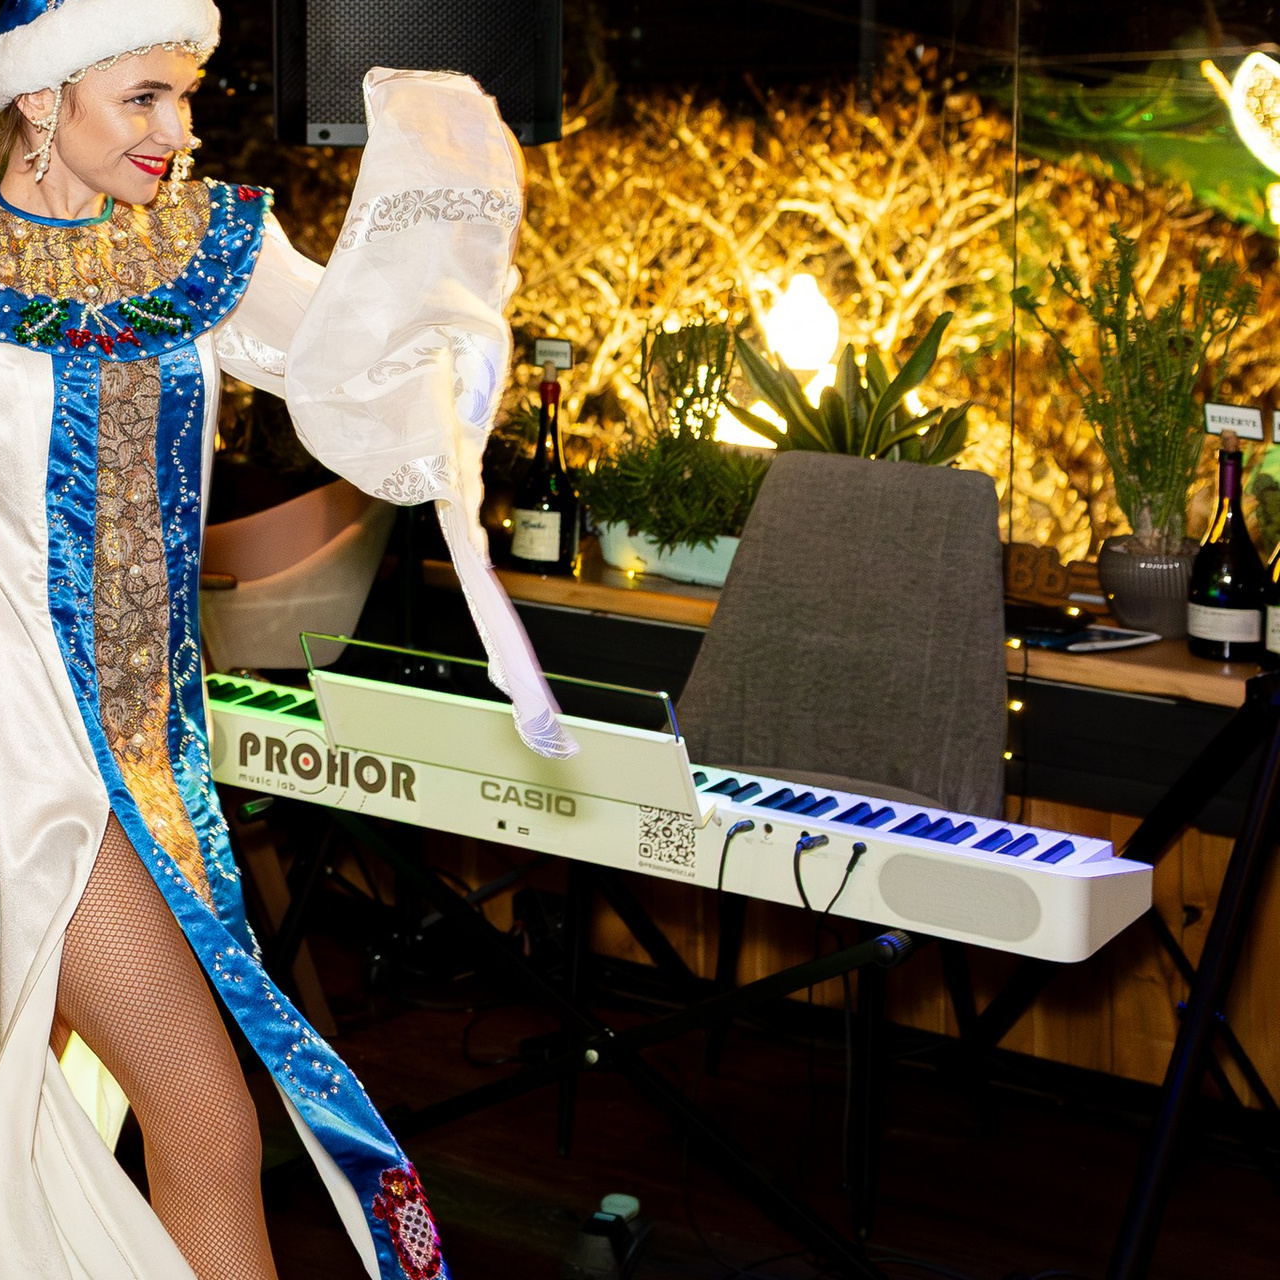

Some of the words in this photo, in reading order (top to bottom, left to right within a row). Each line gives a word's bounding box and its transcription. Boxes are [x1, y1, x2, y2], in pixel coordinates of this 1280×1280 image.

[238, 772, 272, 787] music
[276, 779, 297, 792] lab
[239, 732, 417, 802] PROHOR
[480, 780, 576, 818] CASIO
